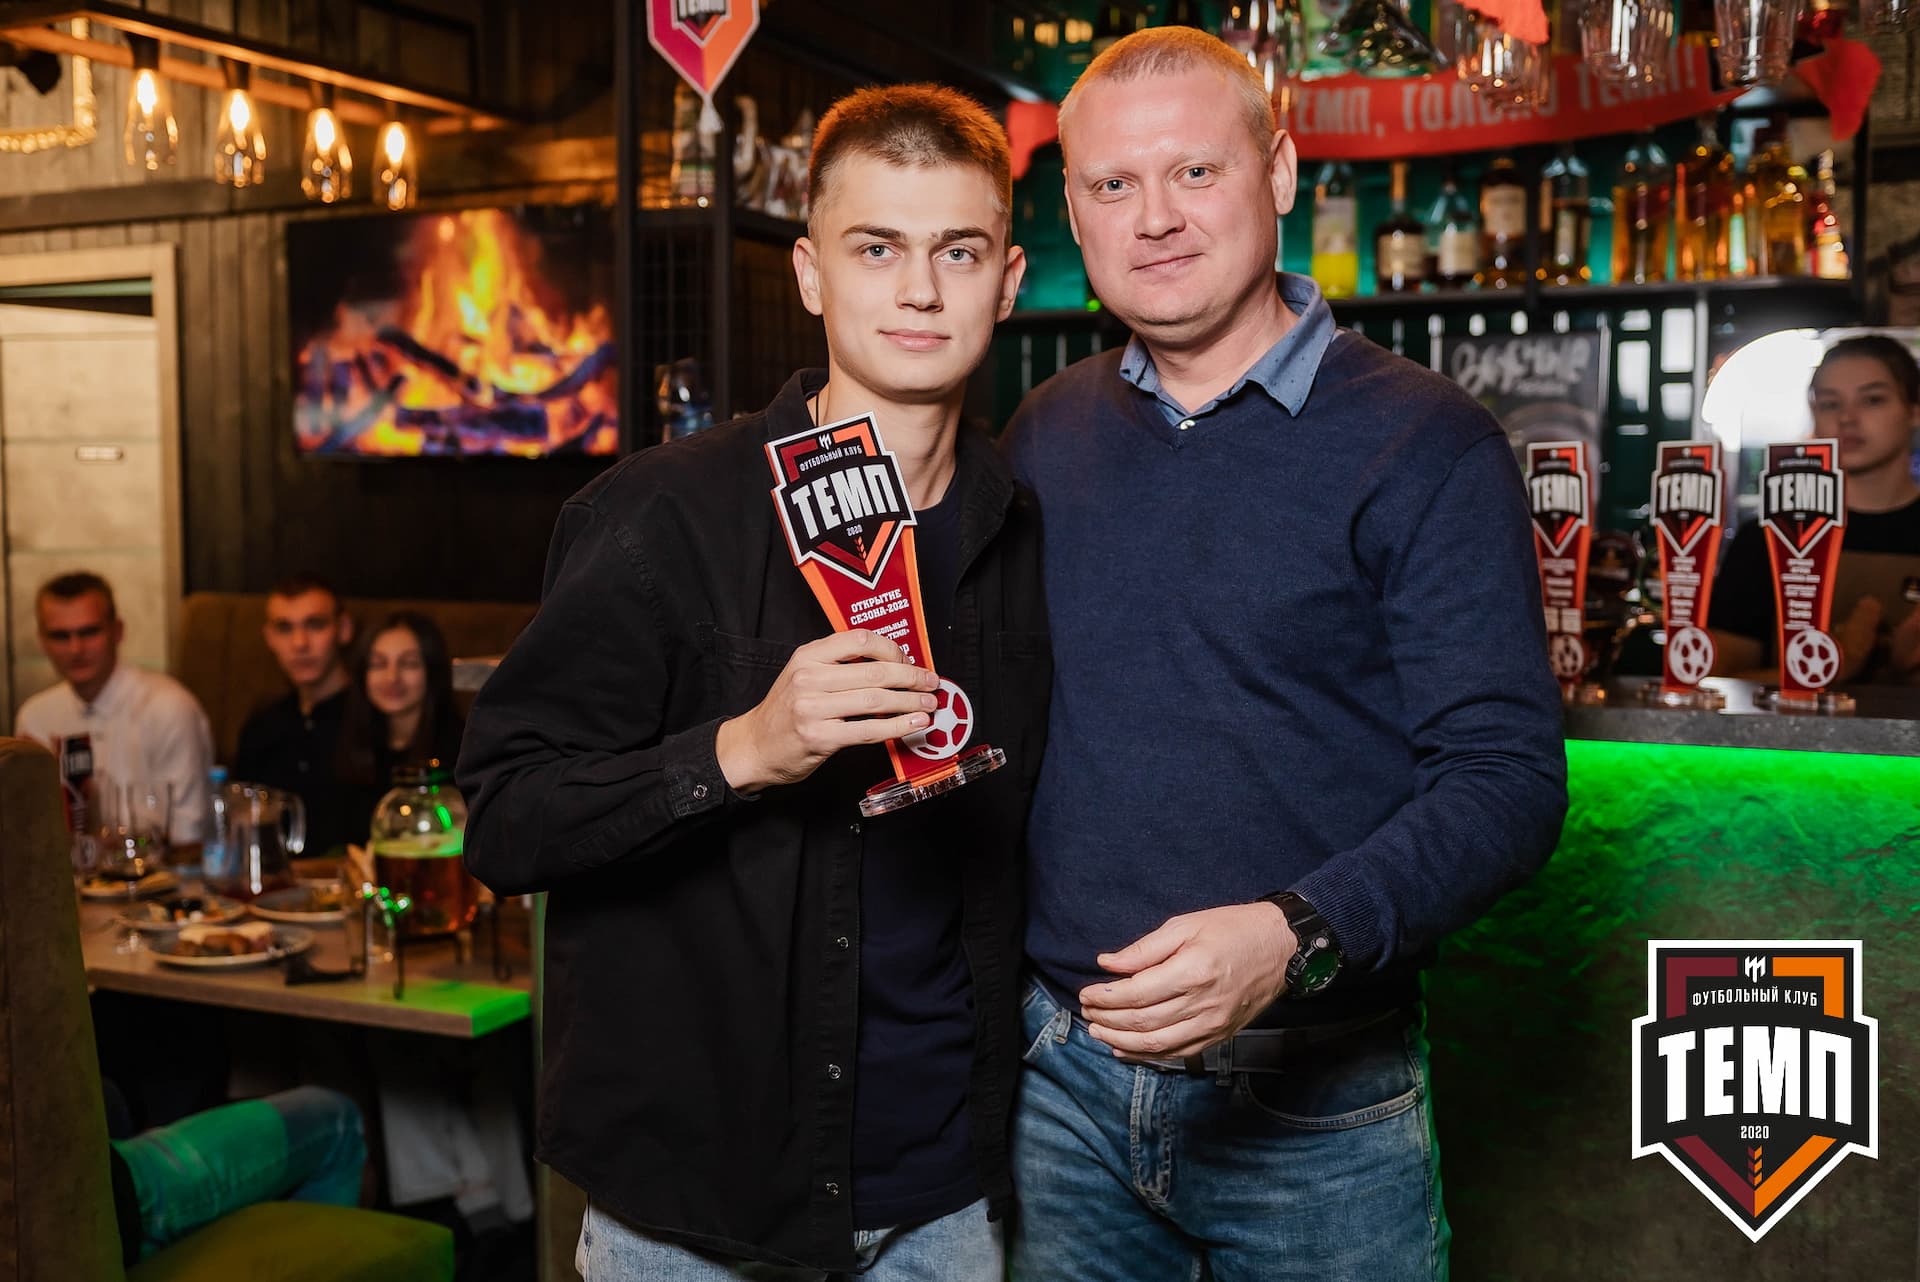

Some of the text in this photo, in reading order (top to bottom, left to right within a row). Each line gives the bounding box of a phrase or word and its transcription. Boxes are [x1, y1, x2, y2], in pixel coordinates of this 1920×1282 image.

[799, 445, 863, 472] ФУТБОЛЬНЫЙ КЛУБ
[790, 464, 901, 540] ТЕМП
[1530, 473, 1582, 515] ТЕМП
[1658, 472, 1714, 514] ТЕМП
[1766, 472, 1835, 515] ТЕМП
[846, 524, 863, 537] 2020
[850, 588, 902, 613] ОТКРЫТИЕ
[850, 598, 910, 626] СЕЗОНА-2022
[872, 618, 909, 636] БОЛЬНЫЙ
